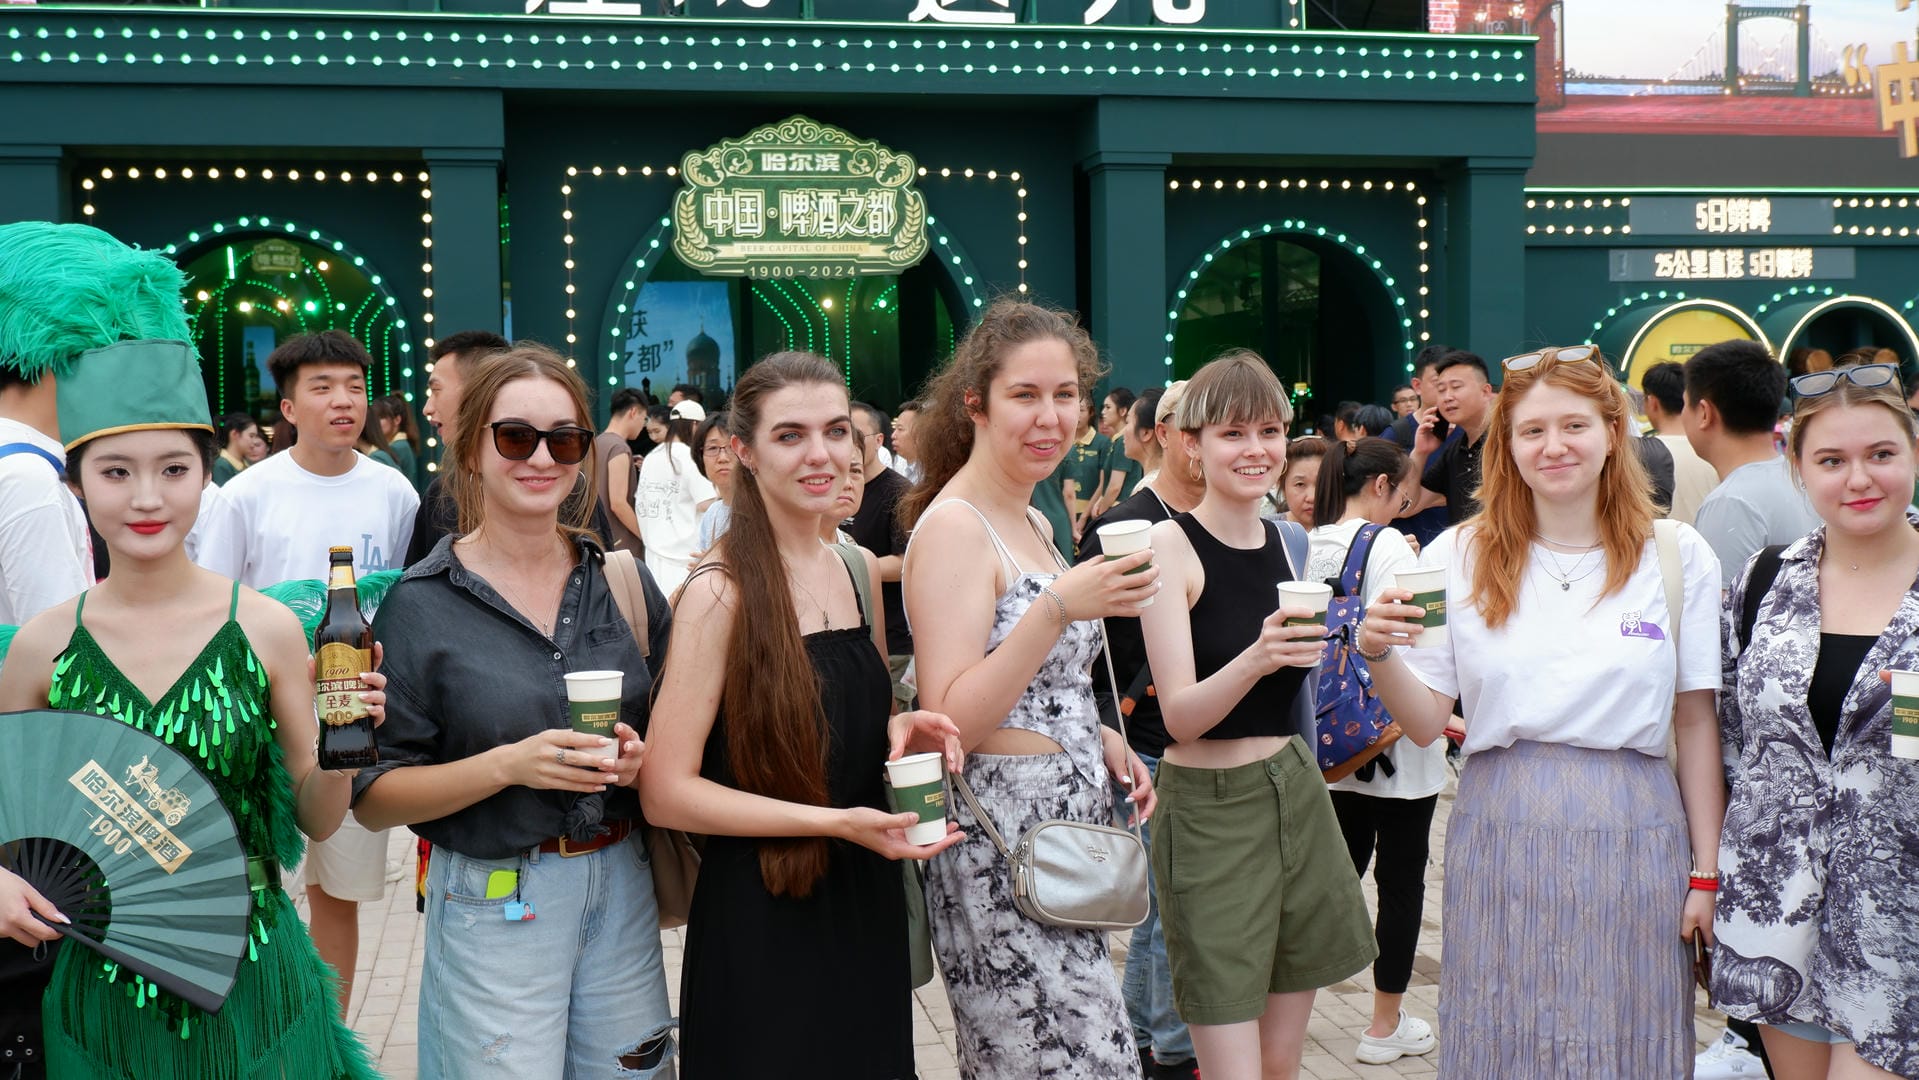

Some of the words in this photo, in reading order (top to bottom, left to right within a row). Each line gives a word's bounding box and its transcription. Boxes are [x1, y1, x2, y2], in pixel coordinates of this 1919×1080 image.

[761, 152, 841, 172] 哈尔滨
[740, 244, 764, 252] BEER
[769, 244, 810, 252] CAPITAL
[815, 244, 826, 252] OF
[831, 244, 864, 252] CHINA
[326, 694, 351, 709] 全麦
[80, 768, 182, 862] 哈尔滨啤酒
[88, 814, 133, 855] 1900
